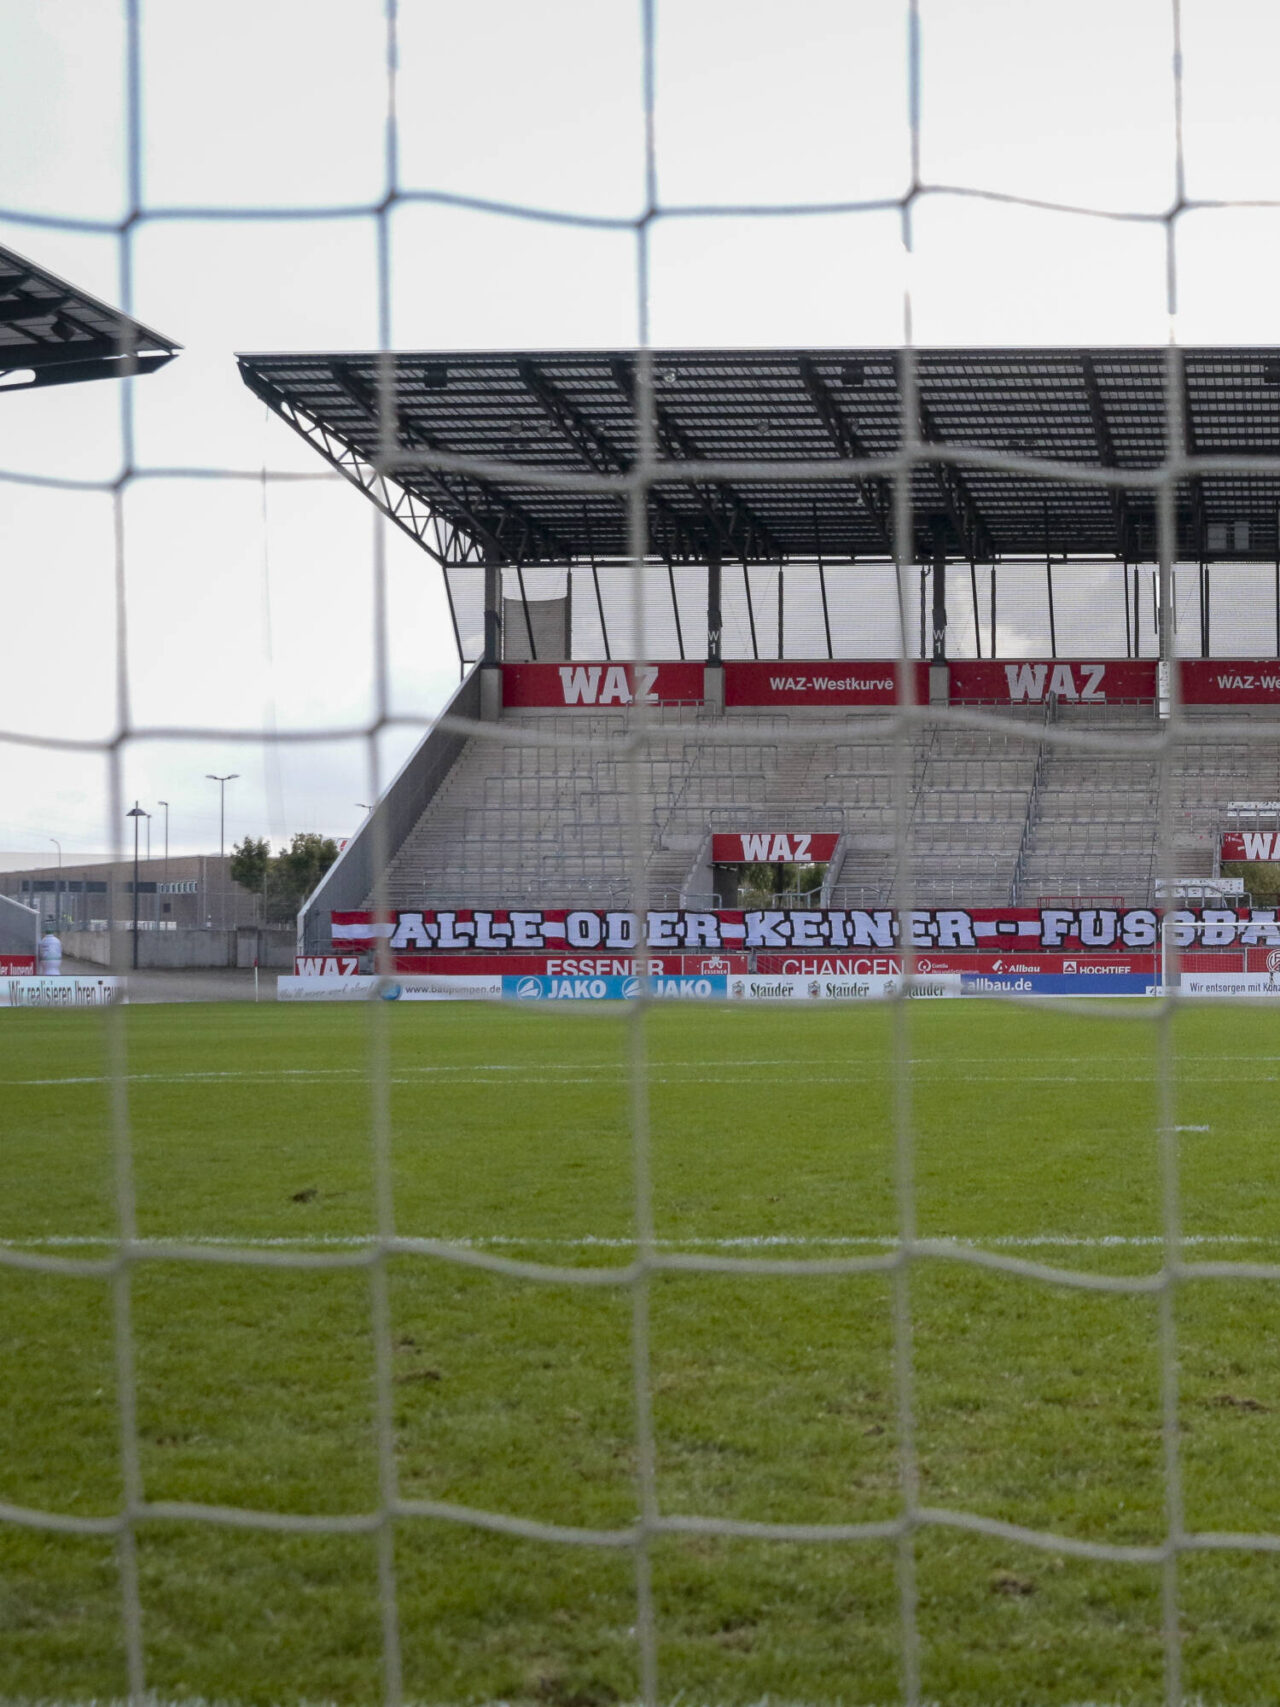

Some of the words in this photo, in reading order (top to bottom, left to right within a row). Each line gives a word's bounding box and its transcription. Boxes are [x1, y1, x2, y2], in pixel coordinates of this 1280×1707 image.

[558, 666, 659, 704] WAZ
[769, 677, 894, 691] WAZ-Westkurve
[1004, 664, 1106, 702] WAZ
[740, 834, 812, 860] WAZ
[389, 909, 547, 950] ALLE
[564, 909, 723, 949] ODER
[743, 909, 979, 949] KEINER
[296, 957, 358, 976] WAZ
[546, 959, 665, 975] ESSENER
[1009, 964, 1040, 973] Allbau
[1080, 966, 1131, 974] HOCHTIEF
[548, 979, 607, 999] JAKO
[653, 979, 712, 999] JAKO
[750, 982, 794, 998] Stauder
[825, 981, 870, 998] Stauder
[968, 977, 1033, 991] allbau.de
[1190, 982, 1204, 992] Wir
[1205, 983, 1245, 995] entsorgen
[1248, 982, 1261, 992] mit
